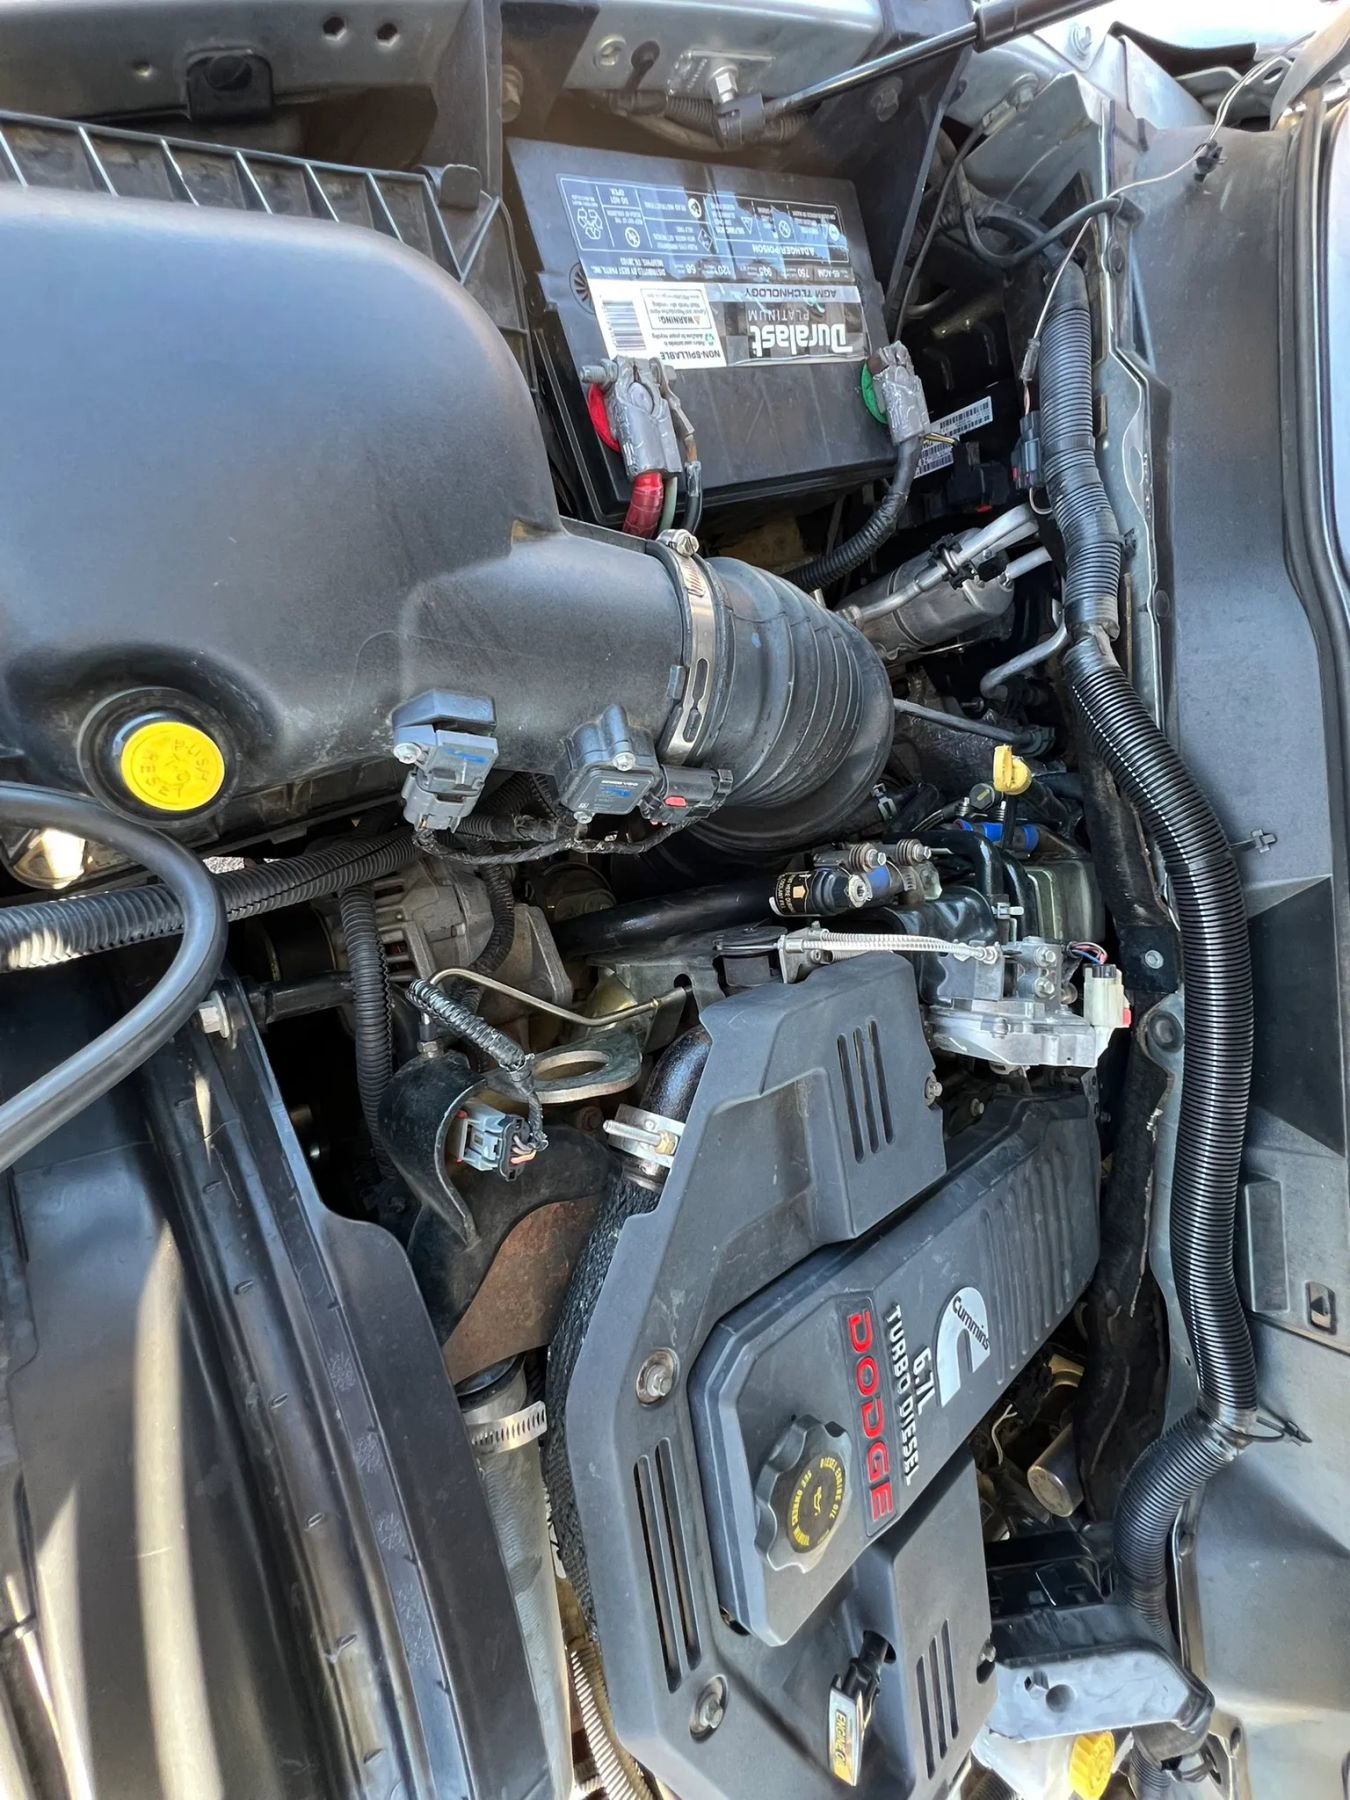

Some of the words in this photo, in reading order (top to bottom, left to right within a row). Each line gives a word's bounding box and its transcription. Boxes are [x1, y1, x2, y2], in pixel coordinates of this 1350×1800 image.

[745, 287, 812, 298] TECHNOLOGY
[816, 289, 837, 298] AGM
[748, 309, 810, 321] PLATINUM
[750, 324, 853, 357] Duralast
[660, 350, 720, 360] NON-SPILLABLE
[952, 1298, 991, 1351] Cummins
[913, 1346, 936, 1415] 6.7L
[886, 1304, 912, 1394] TURBO
[899, 1394, 920, 1487] DIESEL
[848, 1311, 893, 1521] DODGE
[829, 1504, 839, 1519] OIL
